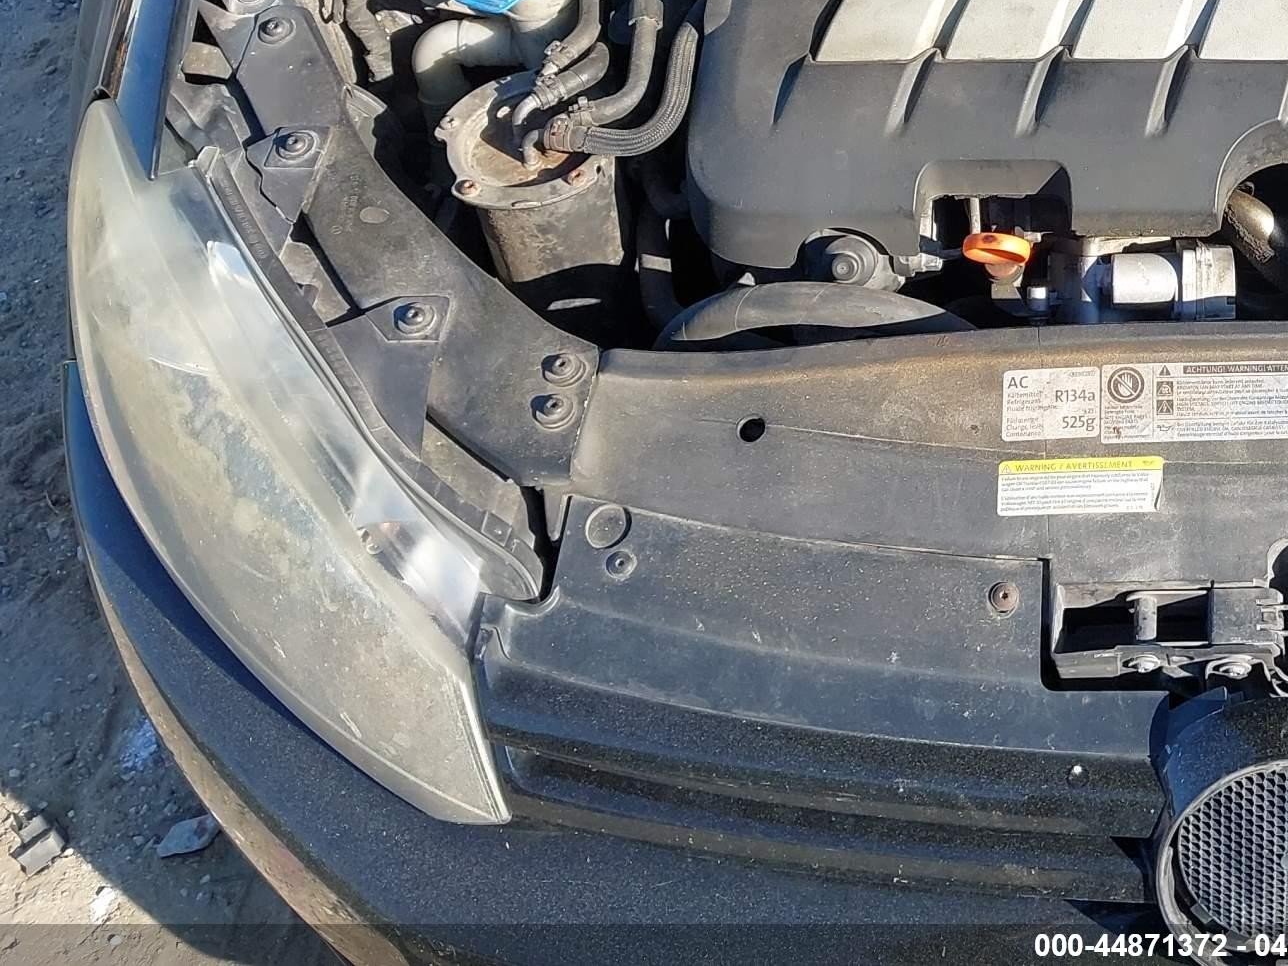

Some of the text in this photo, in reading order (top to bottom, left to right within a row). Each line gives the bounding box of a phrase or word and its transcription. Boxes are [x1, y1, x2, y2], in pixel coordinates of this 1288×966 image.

[1186, 365, 1226, 373] ACHTUNG!
[1007, 375, 1029, 389] AC
[1055, 389, 1096, 403] R134a
[1062, 415, 1096, 432] 525g
[1015, 463, 1057, 472] WARNING
